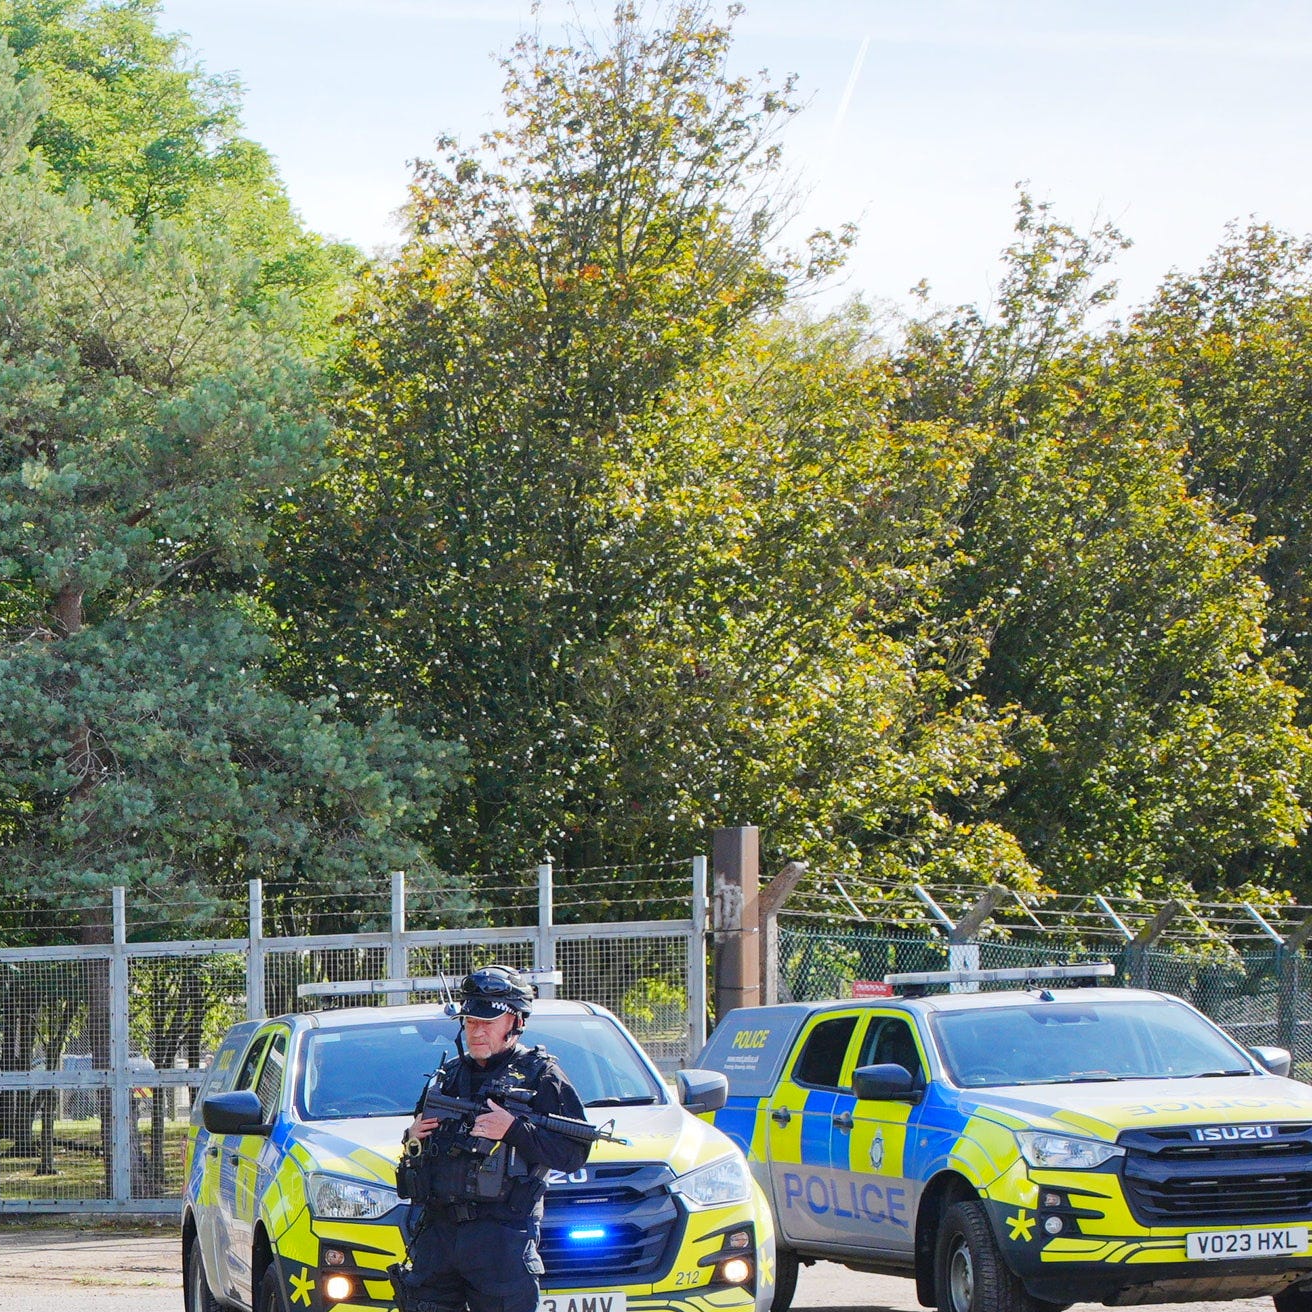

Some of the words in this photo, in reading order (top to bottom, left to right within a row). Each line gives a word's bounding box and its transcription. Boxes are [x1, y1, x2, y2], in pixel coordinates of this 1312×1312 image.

[731, 1029, 771, 1049] POLICE
[1196, 1125, 1274, 1142] ISUZU
[783, 1172, 909, 1229] POLICE
[1197, 1234, 1252, 1254] VO23
[1258, 1231, 1298, 1250] HXL
[675, 1270, 701, 1286] 212
